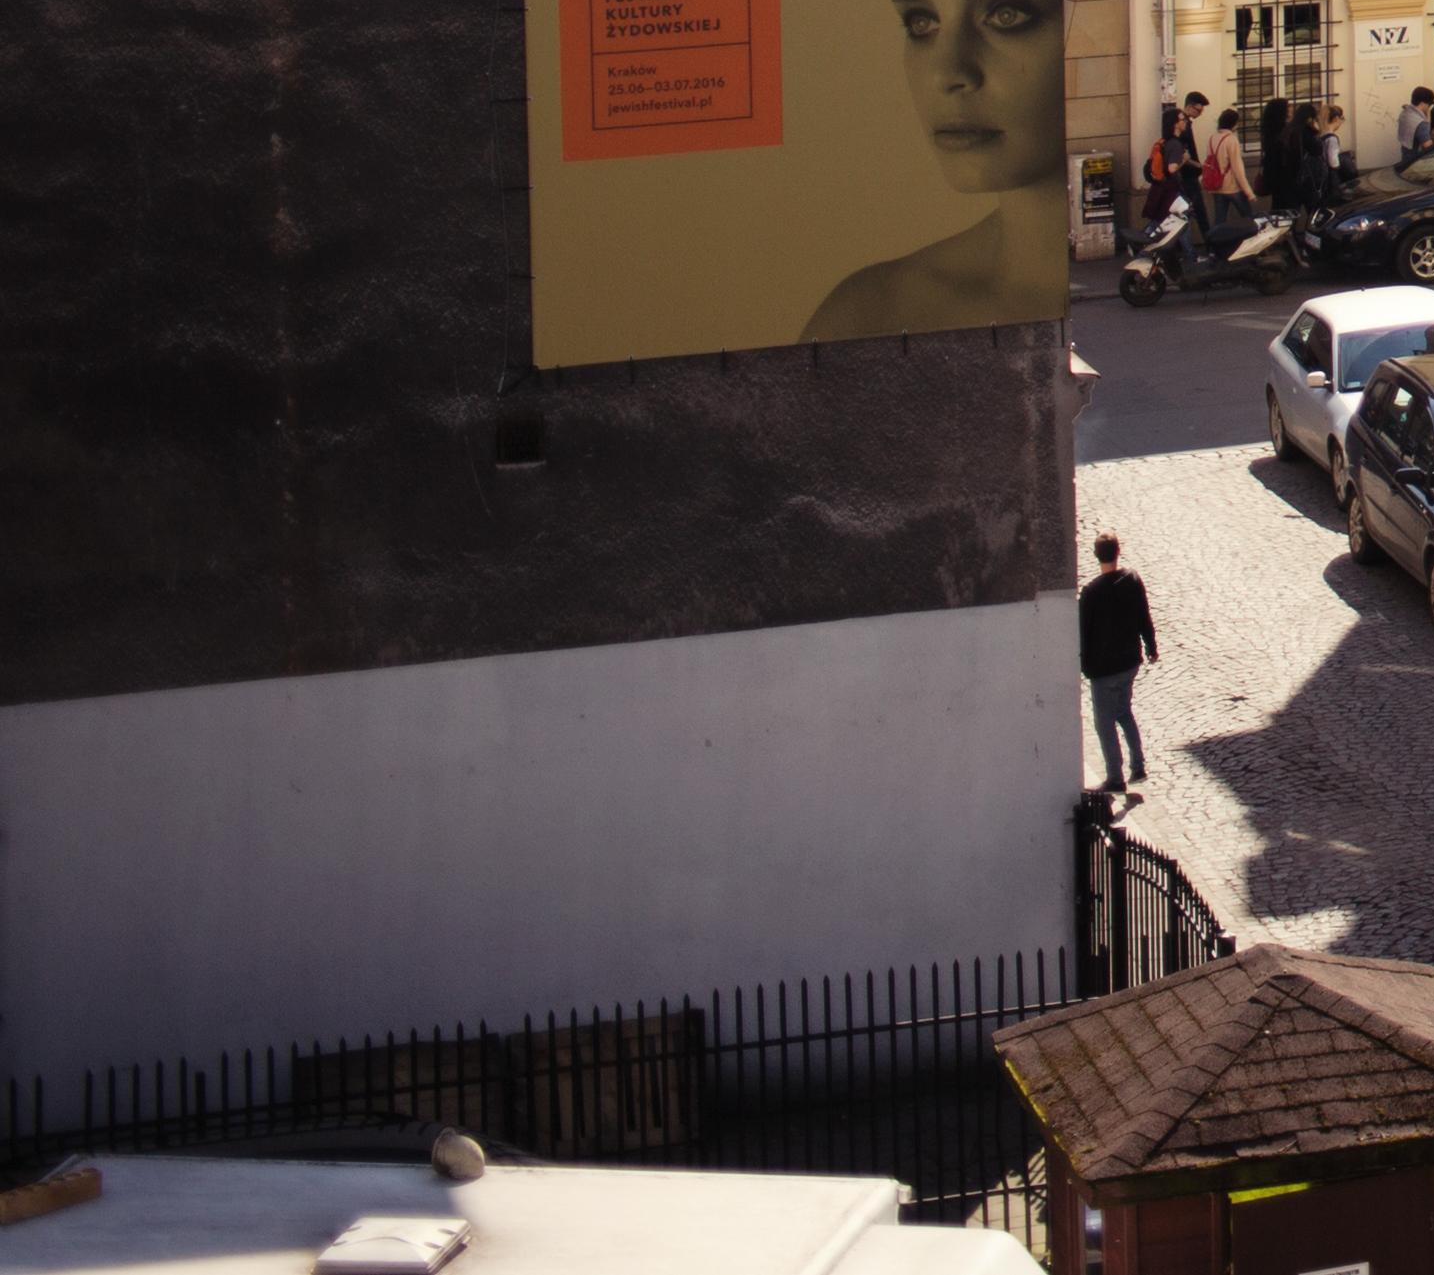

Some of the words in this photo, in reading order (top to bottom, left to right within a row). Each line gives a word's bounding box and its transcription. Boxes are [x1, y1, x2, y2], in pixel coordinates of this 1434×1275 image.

[606, 3, 684, 20] KULTURY
[606, 18, 721, 38] ŻYDOWSKIEJ
[1369, 26, 1410, 47] NFZ
[608, 95, 713, 117] jewishfestival.pl
